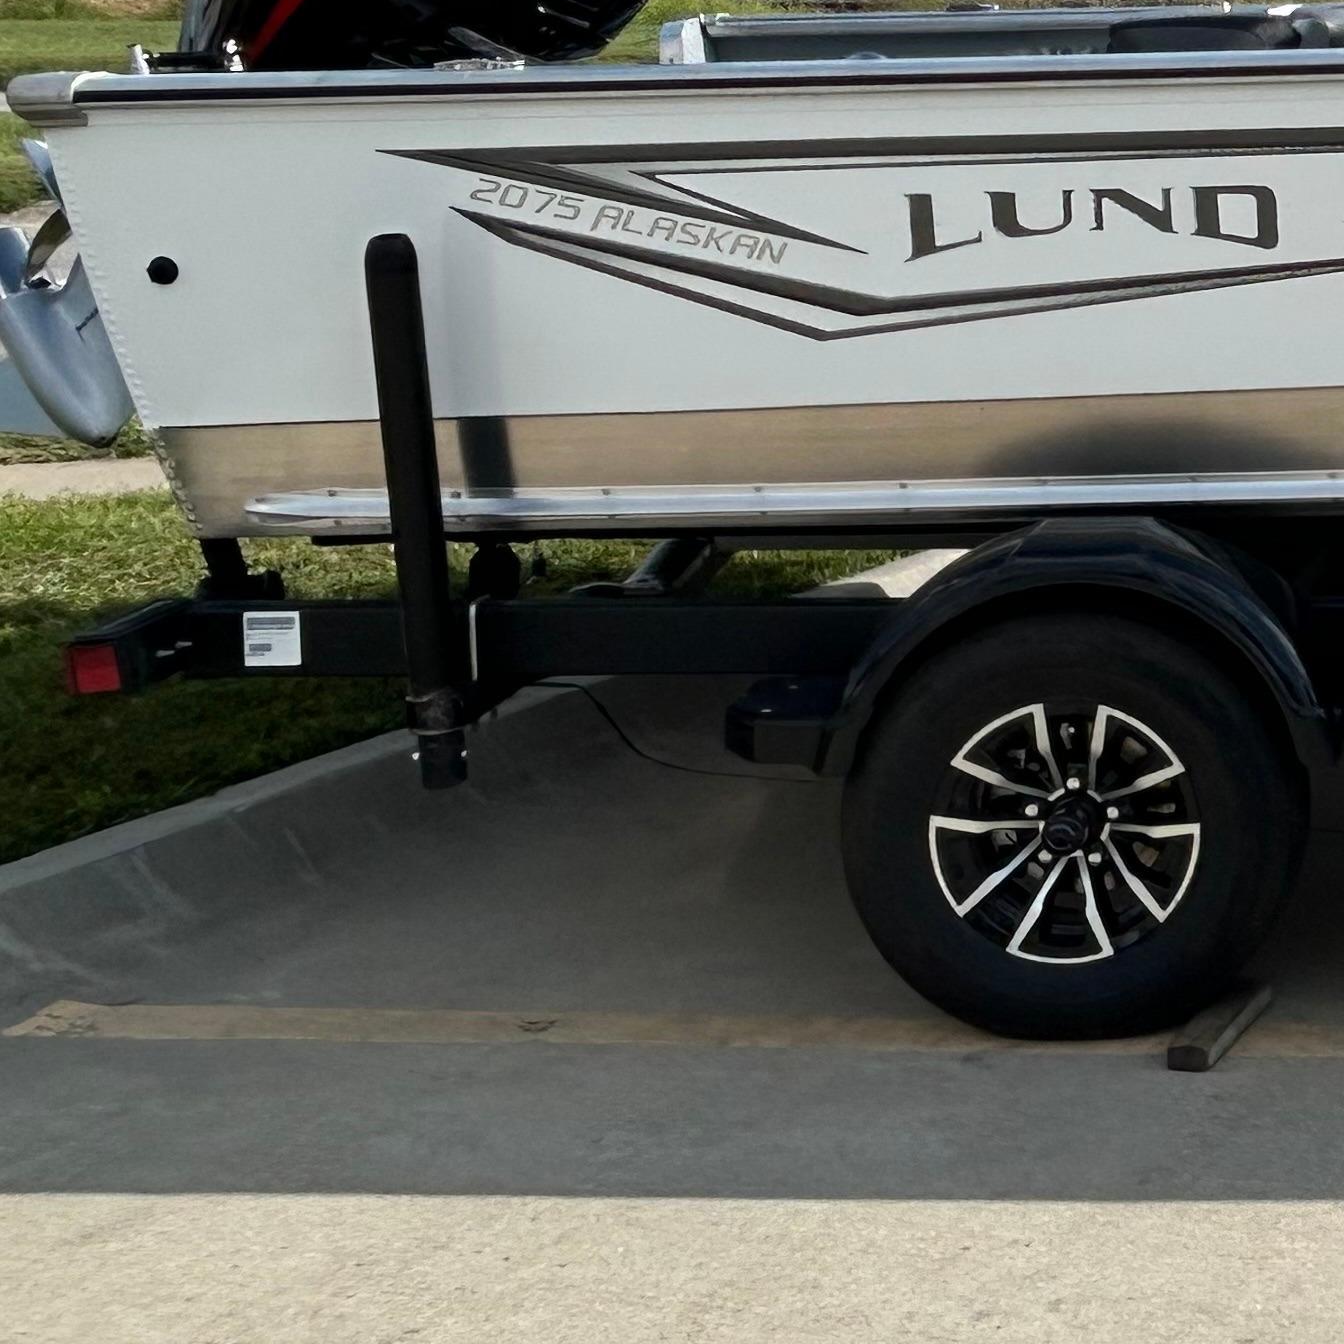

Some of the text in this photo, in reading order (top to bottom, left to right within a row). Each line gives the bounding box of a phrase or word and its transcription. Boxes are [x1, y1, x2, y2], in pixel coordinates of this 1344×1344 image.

[470, 178, 788, 264] 2075 ALASKAN
[903, 185, 1279, 263] LUND
